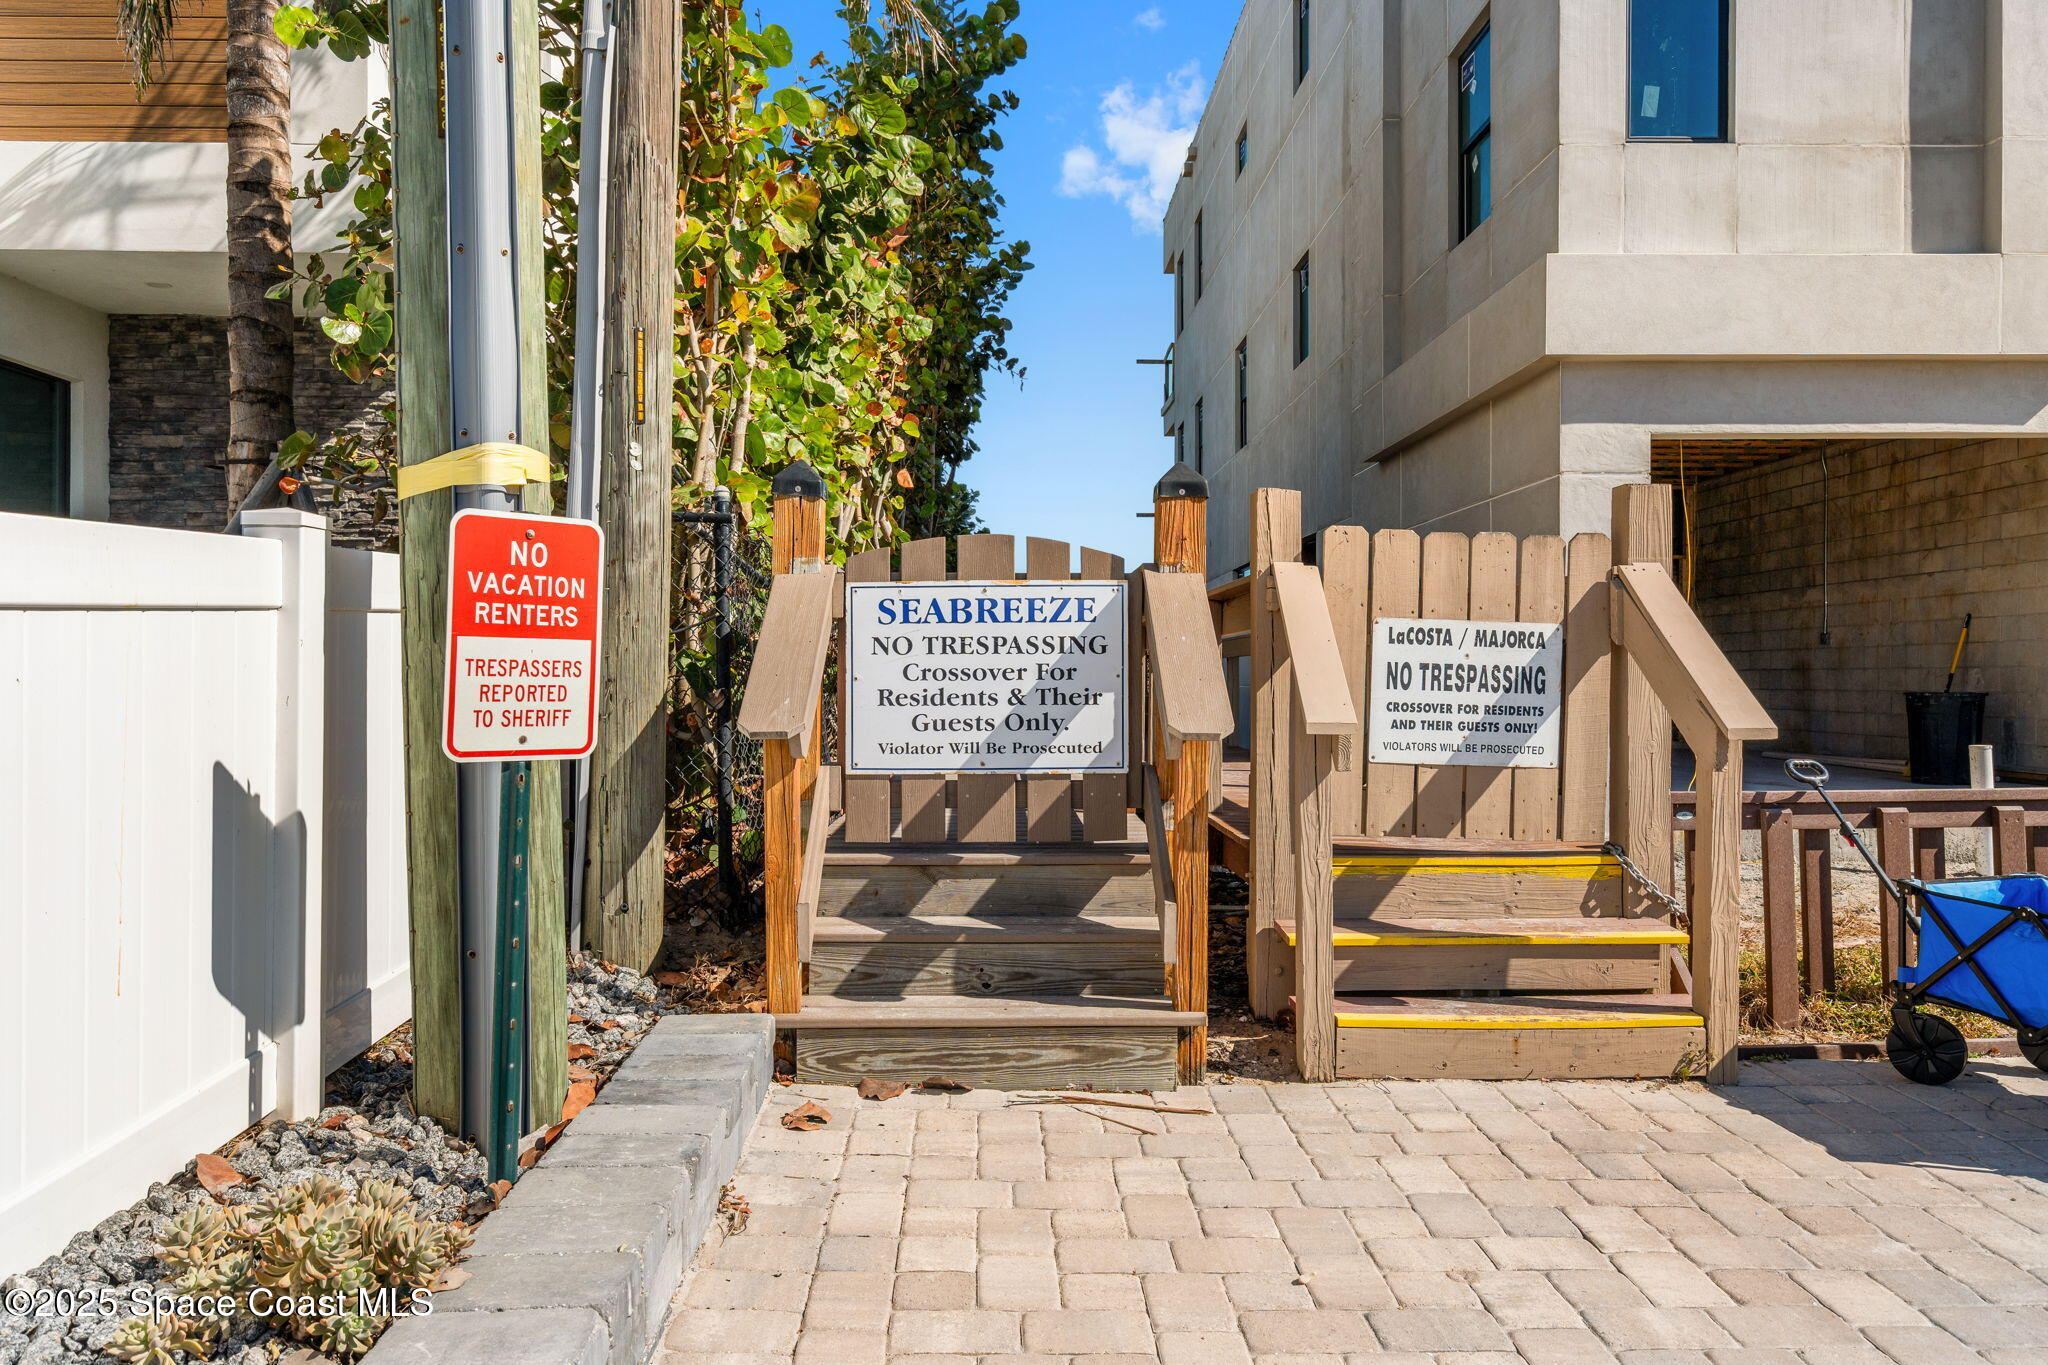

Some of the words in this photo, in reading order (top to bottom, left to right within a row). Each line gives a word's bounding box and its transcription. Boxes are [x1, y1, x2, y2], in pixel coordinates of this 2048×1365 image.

[510, 540, 548, 568] NO
[467, 571, 585, 599] VACATION
[475, 602, 579, 627] RENTERS
[877, 596, 1097, 625] SEABREEZE
[871, 635, 913, 656] NO
[922, 635, 1108, 655] TRESPASSING
[1388, 626, 1453, 646] LaCOSTA
[1458, 627, 1468, 650] /
[1473, 629, 1546, 649] MAJORCA
[465, 658, 582, 678] TRESPASSERS
[902, 663, 1027, 682] Crossover
[1035, 662, 1077, 681] For
[1386, 661, 1412, 690] NO
[1419, 662, 1546, 695] TRESPASSING
[479, 684, 567, 702] REPORTED
[877, 687, 998, 707] Residents
[1007, 687, 1026, 706] &
[1032, 687, 1103, 706] Their
[473, 709, 493, 727] TO
[501, 709, 571, 727] SHERIFF
[1386, 701, 1452, 714] CROSSOVER
[1457, 703, 1479, 715] FOR
[1483, 704, 1544, 716] RESIDENTS
[911, 713, 995, 732] Guests
[1004, 712, 1069, 736] Only.
[1390, 719, 1415, 730] AND
[1420, 720, 1452, 731] THEIR
[1457, 721, 1499, 732] GUESTS
[1504, 722, 1538, 733] ONLY!
[878, 742, 943, 755] Violator
[948, 742, 980, 754] Will
[986, 742, 1006, 754] Be
[1012, 741, 1102, 755] Prosecuted
[1382, 741, 1436, 751] VIOLATORS
[1439, 743, 1462, 752] WILL
[1465, 744, 1477, 752] BE
[1480, 744, 1544, 755] PROSECUTED
